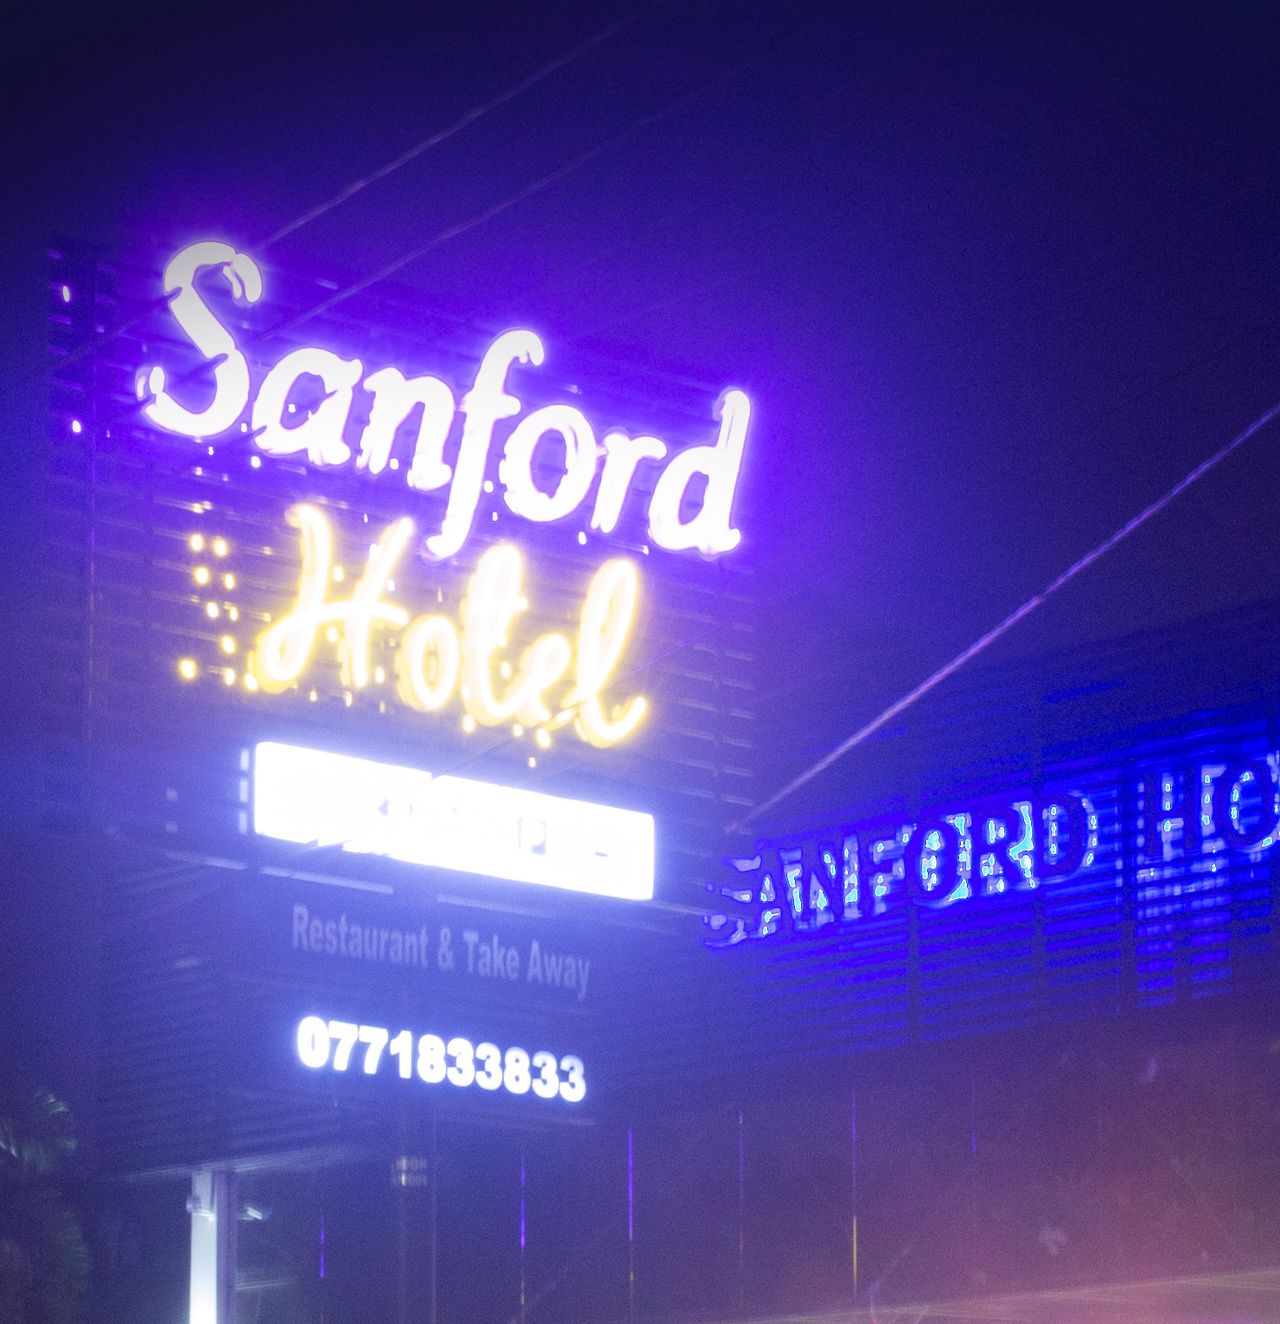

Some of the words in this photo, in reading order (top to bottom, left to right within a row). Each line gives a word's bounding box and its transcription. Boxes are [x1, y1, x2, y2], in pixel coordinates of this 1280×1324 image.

[135, 240, 752, 560] Sanford
[252, 502, 648, 748] Hotel
[704, 790, 1097, 948] SANFORD
[291, 902, 428, 968] Restaurant
[436, 926, 456, 972] &
[462, 929, 520, 981] Take
[526, 939, 591, 1002] Away
[296, 1015, 587, 1103] 0771833833
